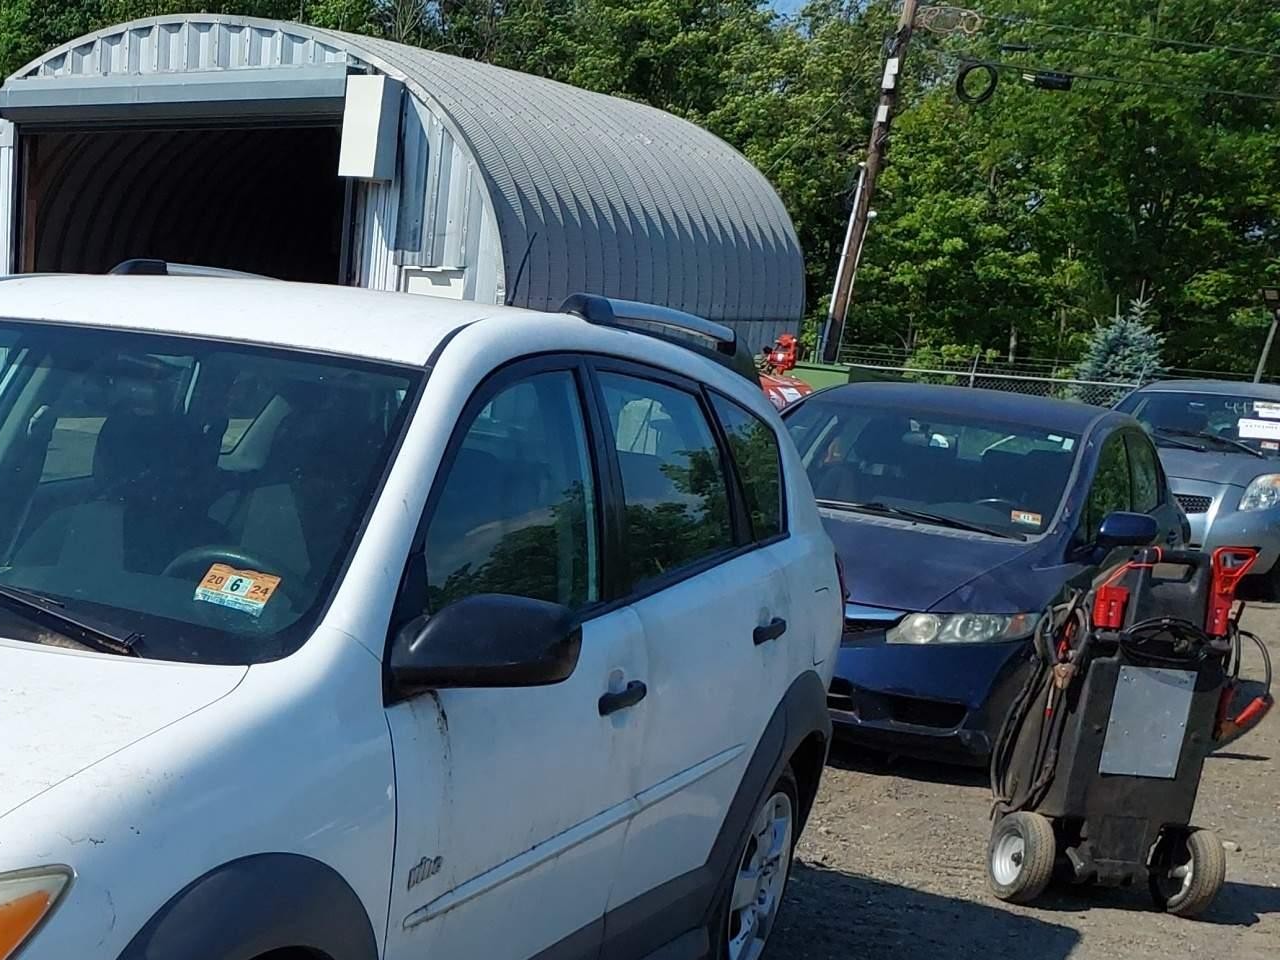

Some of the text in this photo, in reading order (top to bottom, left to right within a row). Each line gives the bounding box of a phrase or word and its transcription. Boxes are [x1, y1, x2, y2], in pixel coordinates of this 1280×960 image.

[207, 574, 269, 597] 20 6 24
